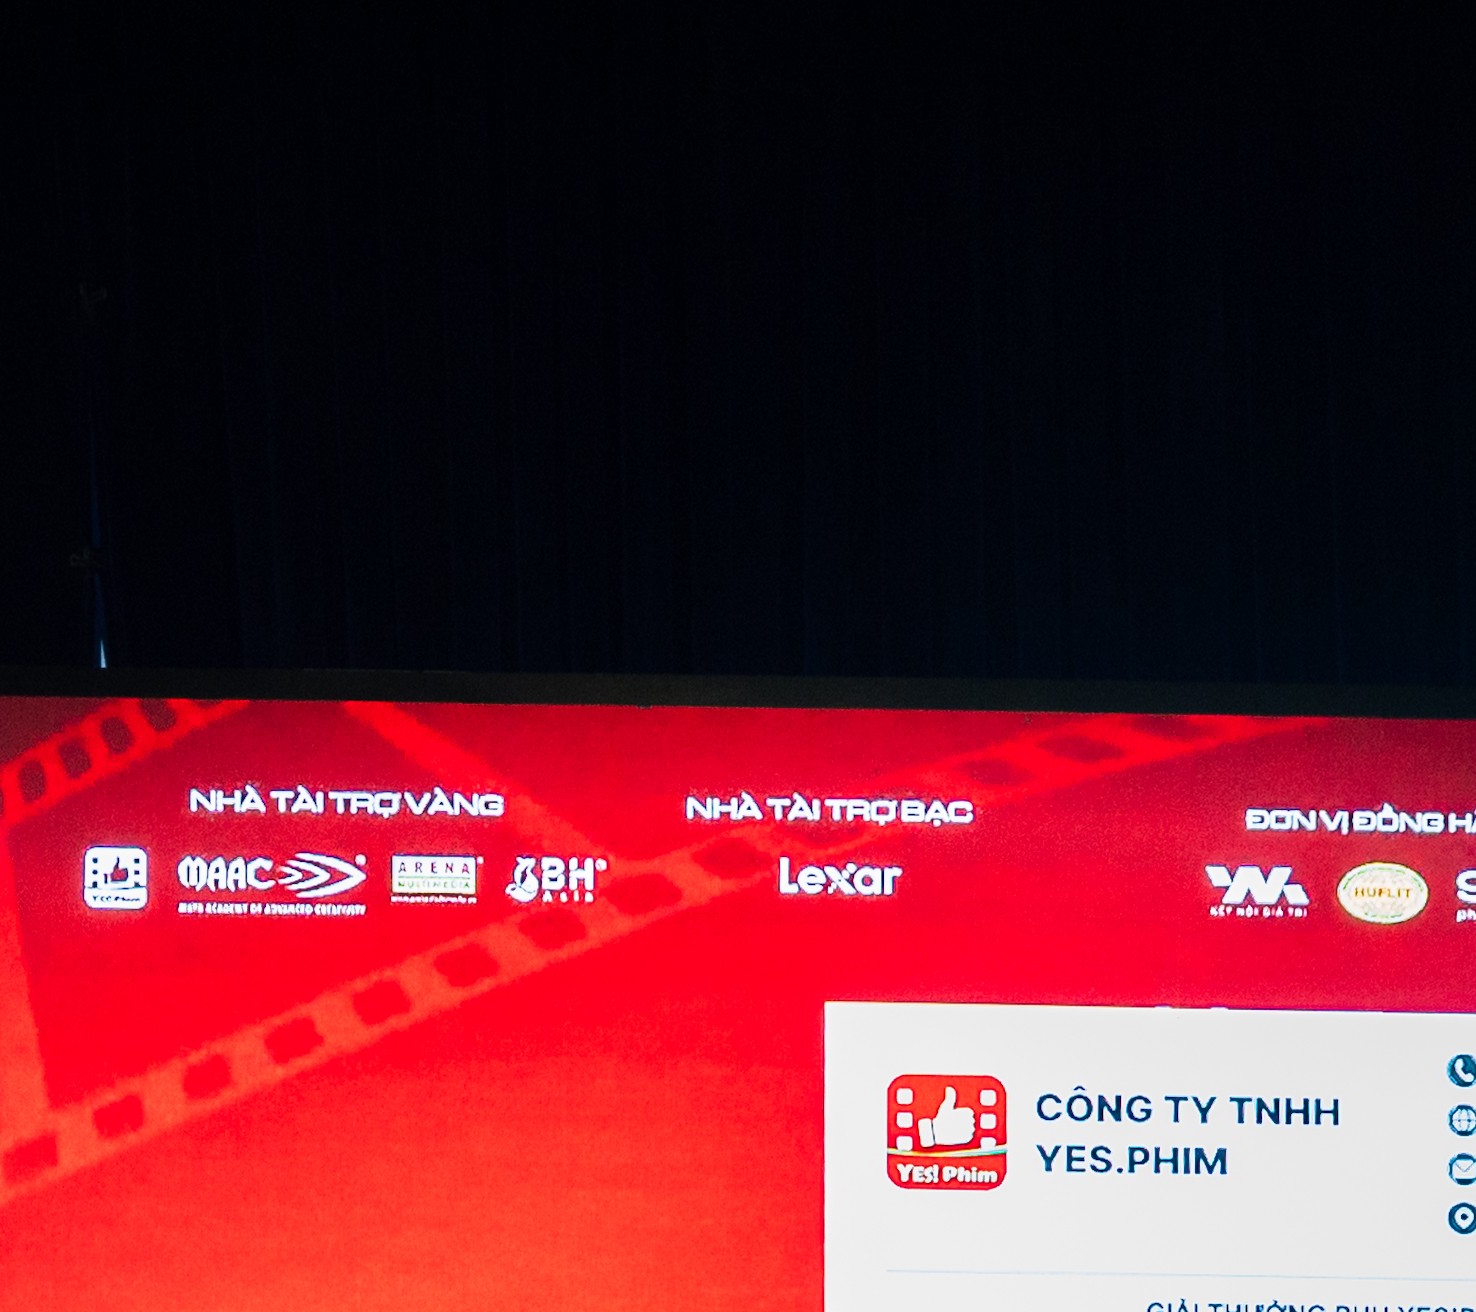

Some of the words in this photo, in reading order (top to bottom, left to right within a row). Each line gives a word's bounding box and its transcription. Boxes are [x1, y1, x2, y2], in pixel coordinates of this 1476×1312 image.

[189, 784, 266, 813] NHÀ
[269, 784, 324, 815] TÀI
[329, 791, 402, 818] TRỢ
[404, 786, 505, 817] VÀNG
[685, 792, 763, 820] NHÀ
[766, 791, 822, 821] TÀI
[824, 797, 898, 826] TRỢ
[900, 800, 975, 828] BẠC
[1245, 808, 1317, 832] ĐƠN
[1318, 810, 1349, 836] VỊ
[1352, 802, 1445, 835] ĐỒNG
[177, 855, 276, 892] MAAC
[398, 861, 471, 874] ARENA
[779, 856, 903, 895] Lexar
[1354, 887, 1413, 899] HUFLIT
[1036, 1086, 1153, 1122] CÔNG
[1164, 1096, 1218, 1124] TY
[1229, 1097, 1341, 1126] TNHH
[896, 1162, 939, 1185] YES!
[941, 1165, 999, 1186] Phim
[1036, 1145, 1228, 1175] YES.PHIM
